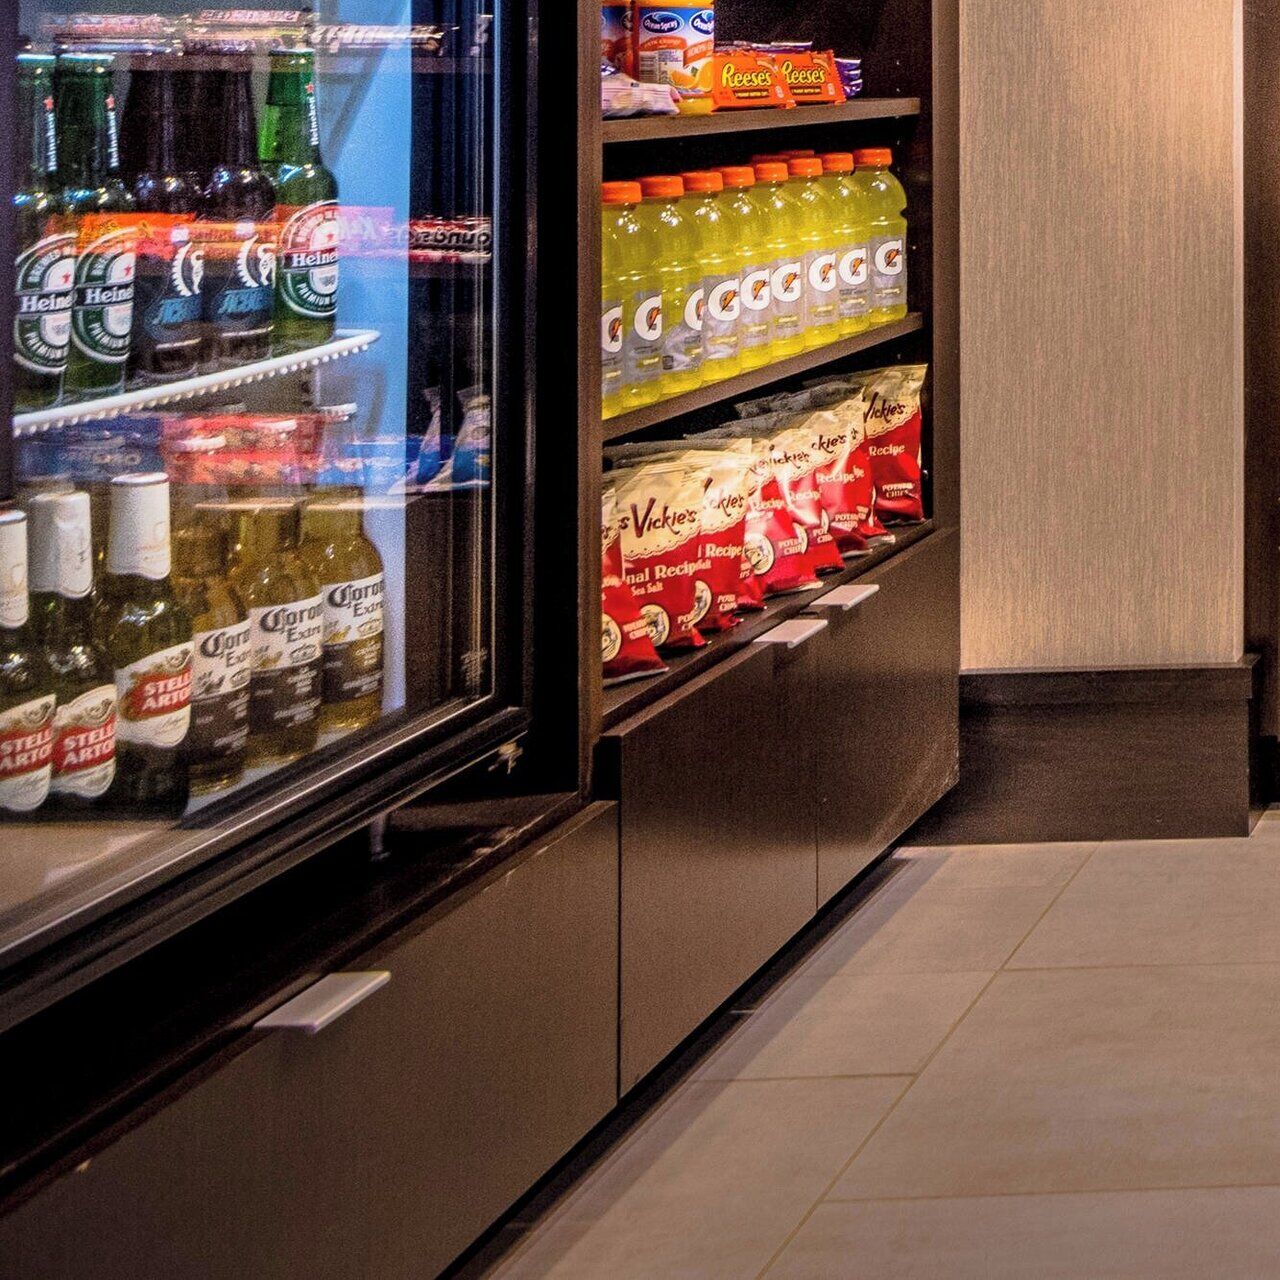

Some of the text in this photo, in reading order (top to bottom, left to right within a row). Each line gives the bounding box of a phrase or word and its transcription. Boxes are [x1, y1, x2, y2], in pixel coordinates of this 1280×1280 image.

[722, 62, 772, 88] Reese's
[781, 61, 826, 84] Reese's
[307, 96, 320, 146] Heineken
[808, 253, 837, 293] G
[839, 247, 867, 286] G
[875, 239, 902, 276] G
[707, 278, 740, 321] G
[740, 269, 770, 310] G
[770, 261, 800, 302] G
[602, 306, 623, 352] G
[634, 296, 662, 341] G
[869, 445, 906, 456] Recipe
[630, 497, 698, 539] Vickie's
[706, 543, 742, 559] Recipe
[631, 581, 664, 597] Sea Salt
[141, 687, 191, 712] ARTO
[144, 666, 191, 697] STELL
[63, 724, 114, 749] STELL
